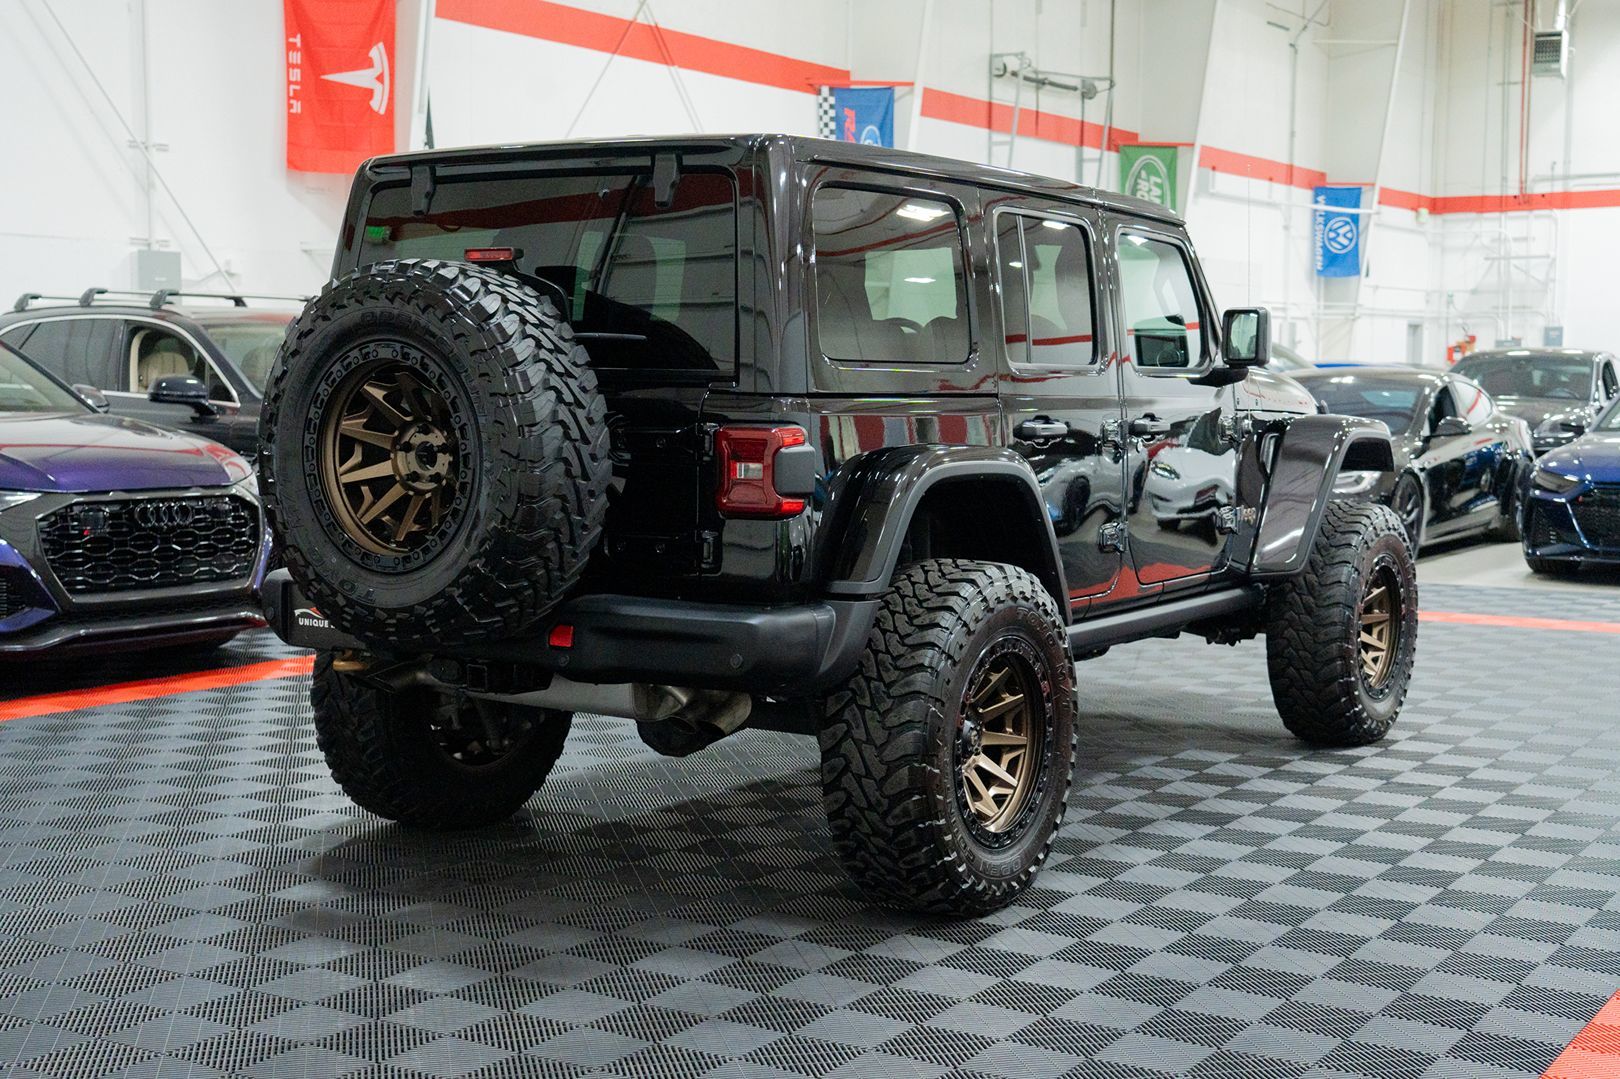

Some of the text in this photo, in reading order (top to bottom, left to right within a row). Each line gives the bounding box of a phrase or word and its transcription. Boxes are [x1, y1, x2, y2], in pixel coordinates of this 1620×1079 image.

[288, 33, 301, 113] TESLA
[1149, 175, 1162, 204] LAN
[1315, 194, 1326, 271] VLKSWAGEN
[298, 617, 329, 628] UNIQUE
